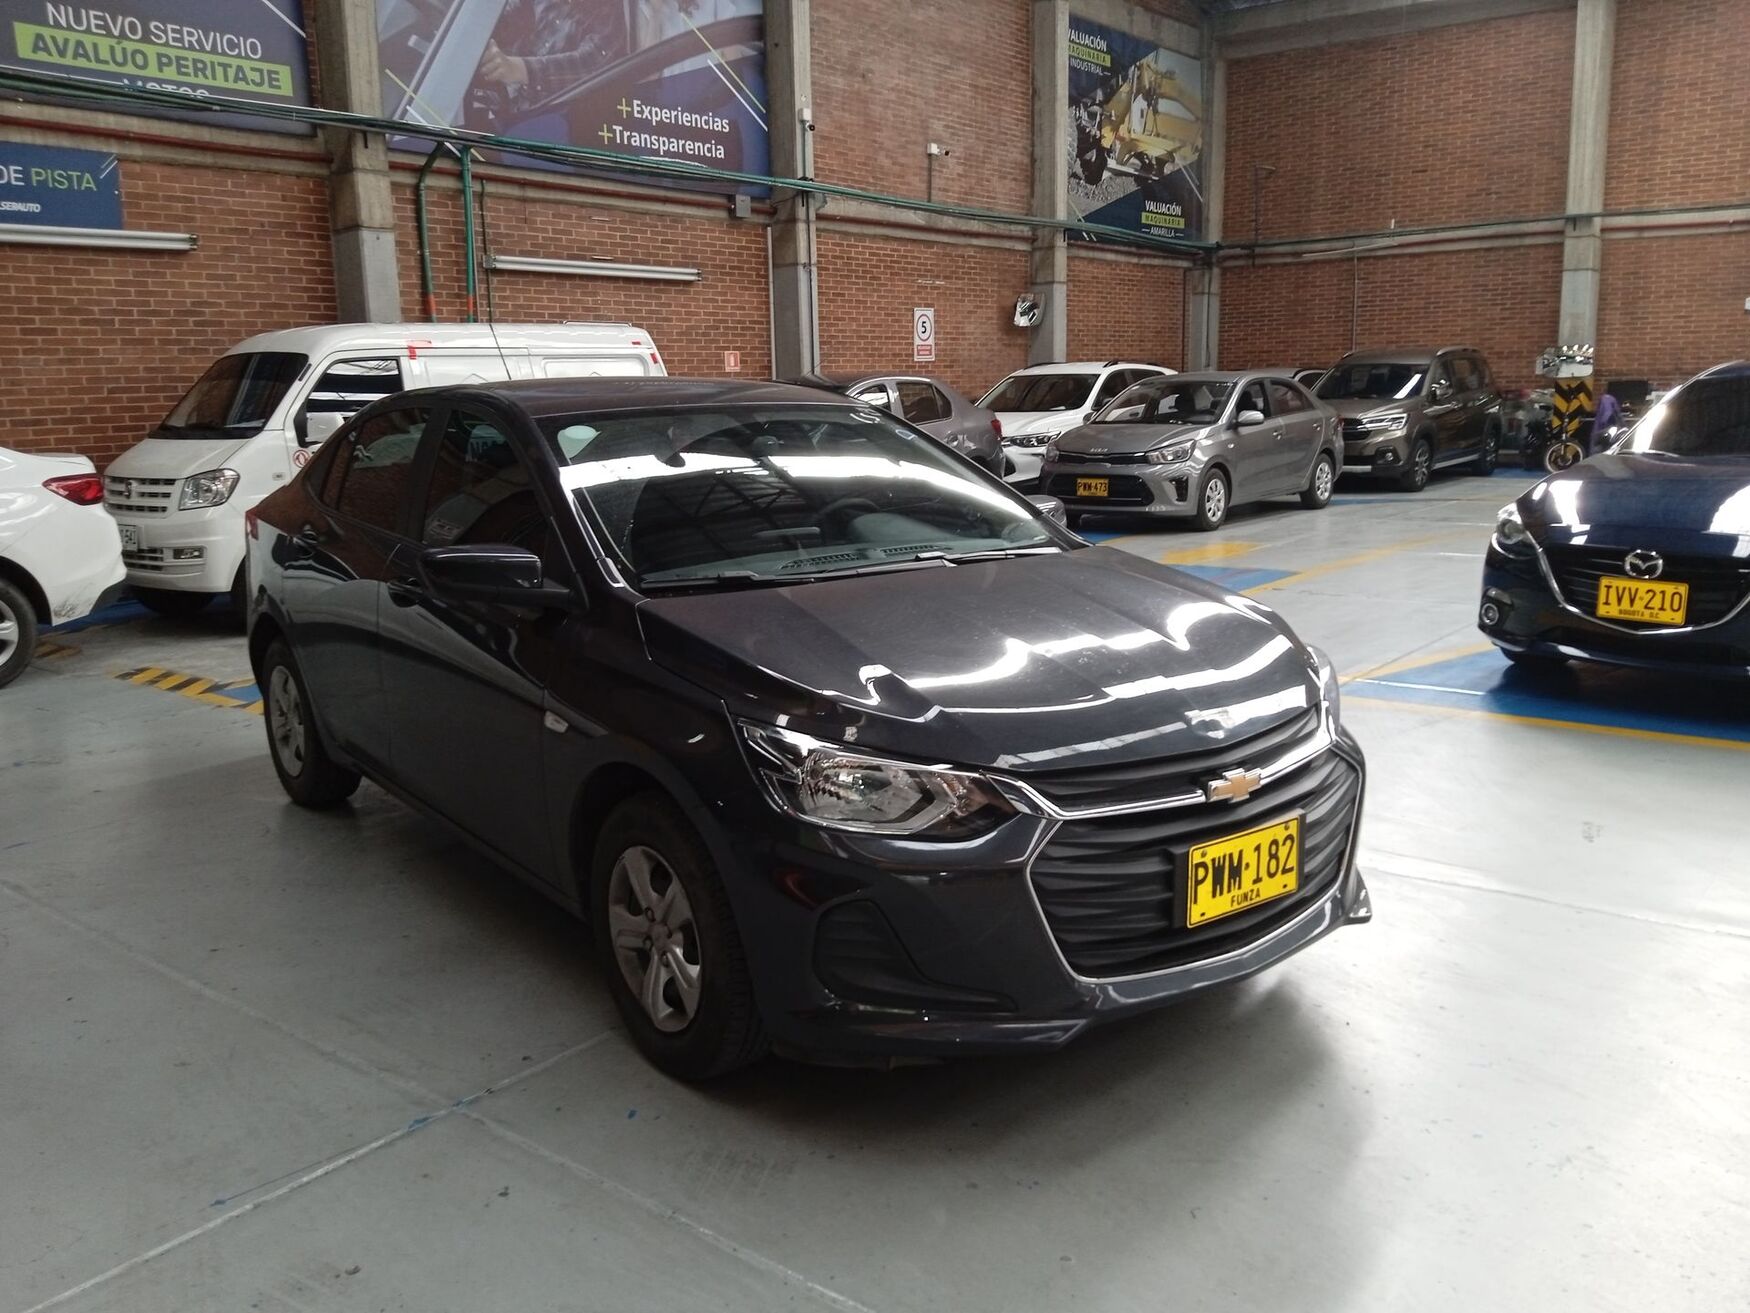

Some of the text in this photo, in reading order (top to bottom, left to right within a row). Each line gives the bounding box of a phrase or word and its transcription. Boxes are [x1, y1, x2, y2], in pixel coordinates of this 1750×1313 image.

[46, 1, 262, 59] NUEVO SERVICIO
[31, 32, 149, 71] AVALÚO
[156, 52, 282, 90] PERITAJE
[1069, 44, 1106, 63] AQUINARIA
[1071, 58, 1103, 76] INDUSTRIAL
[31, 168, 97, 191] PISTA
[1145, 200, 1182, 216] VALUACIÓN
[1150, 226, 1175, 237] AMARILLA
[921, 320, 927, 334] 5
[1230, 887, 1261, 908] FUNZA
